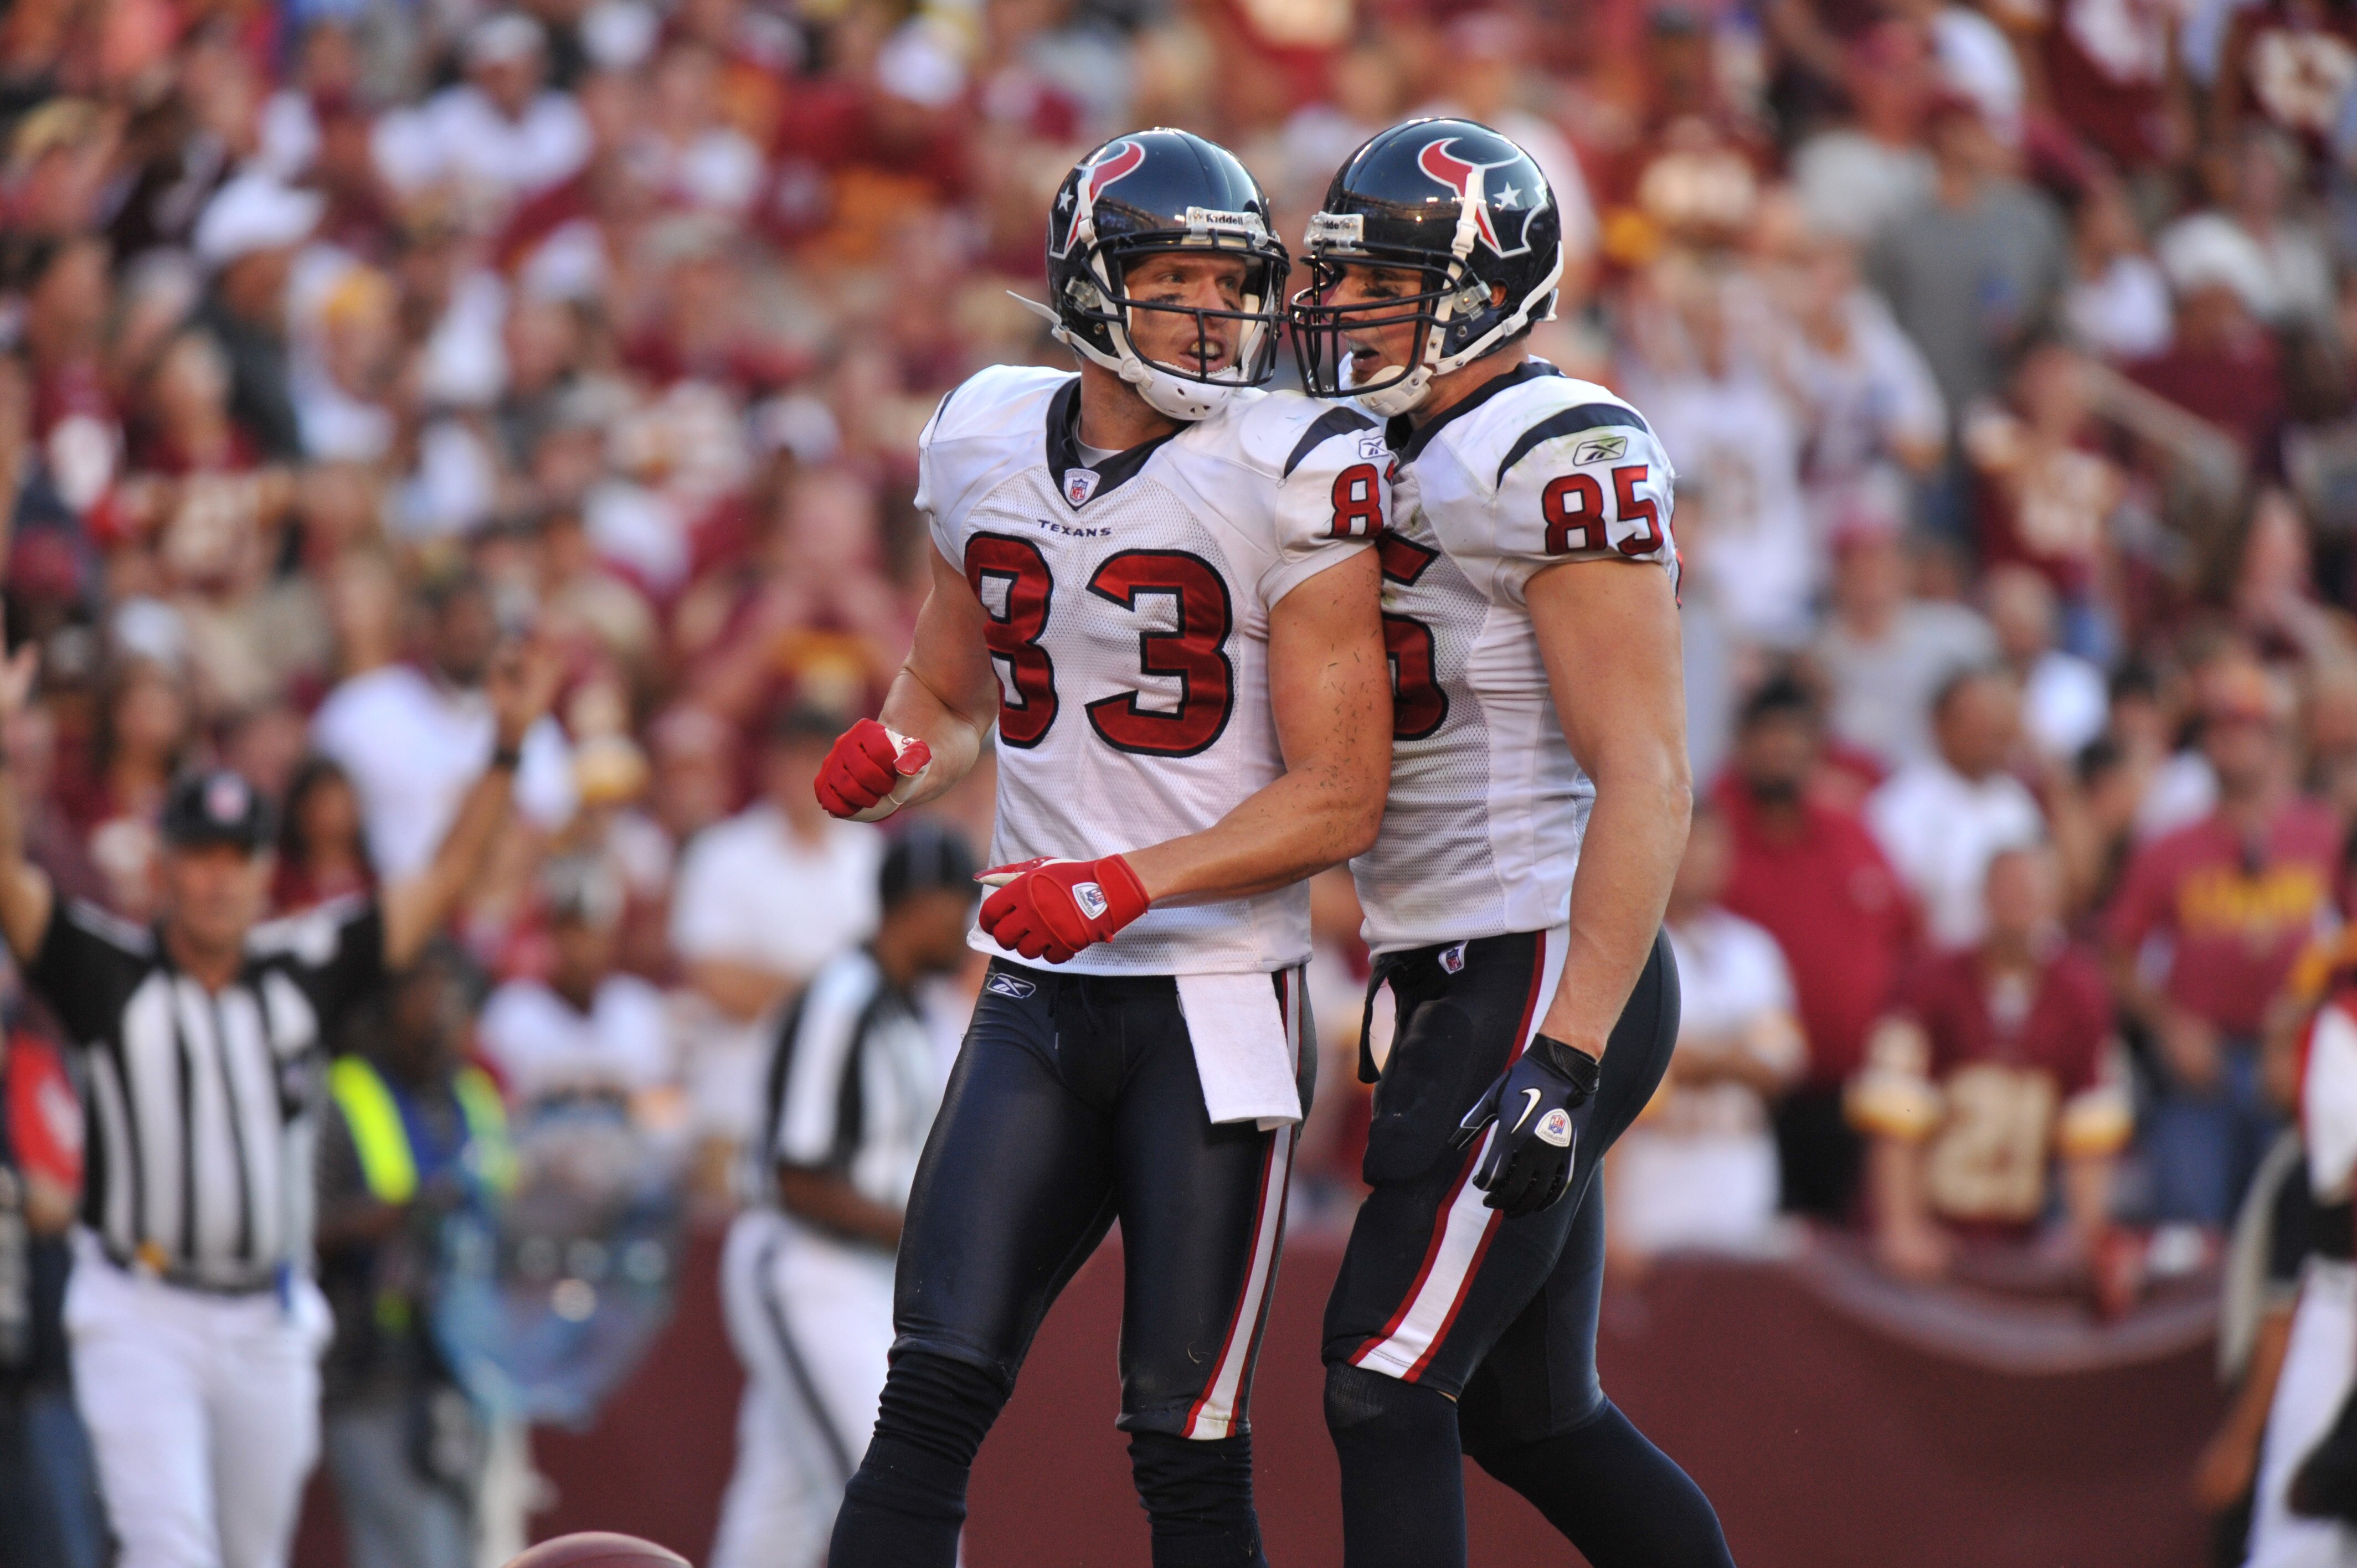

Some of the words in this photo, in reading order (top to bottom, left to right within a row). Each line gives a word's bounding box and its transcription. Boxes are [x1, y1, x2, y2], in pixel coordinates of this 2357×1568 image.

[1070, 487, 1085, 499] NFL
[1542, 464, 1664, 555] 85
[1037, 519, 1111, 537] TEXANS
[964, 530, 1234, 759] 83
[1551, 1115, 1564, 1128] NFL
